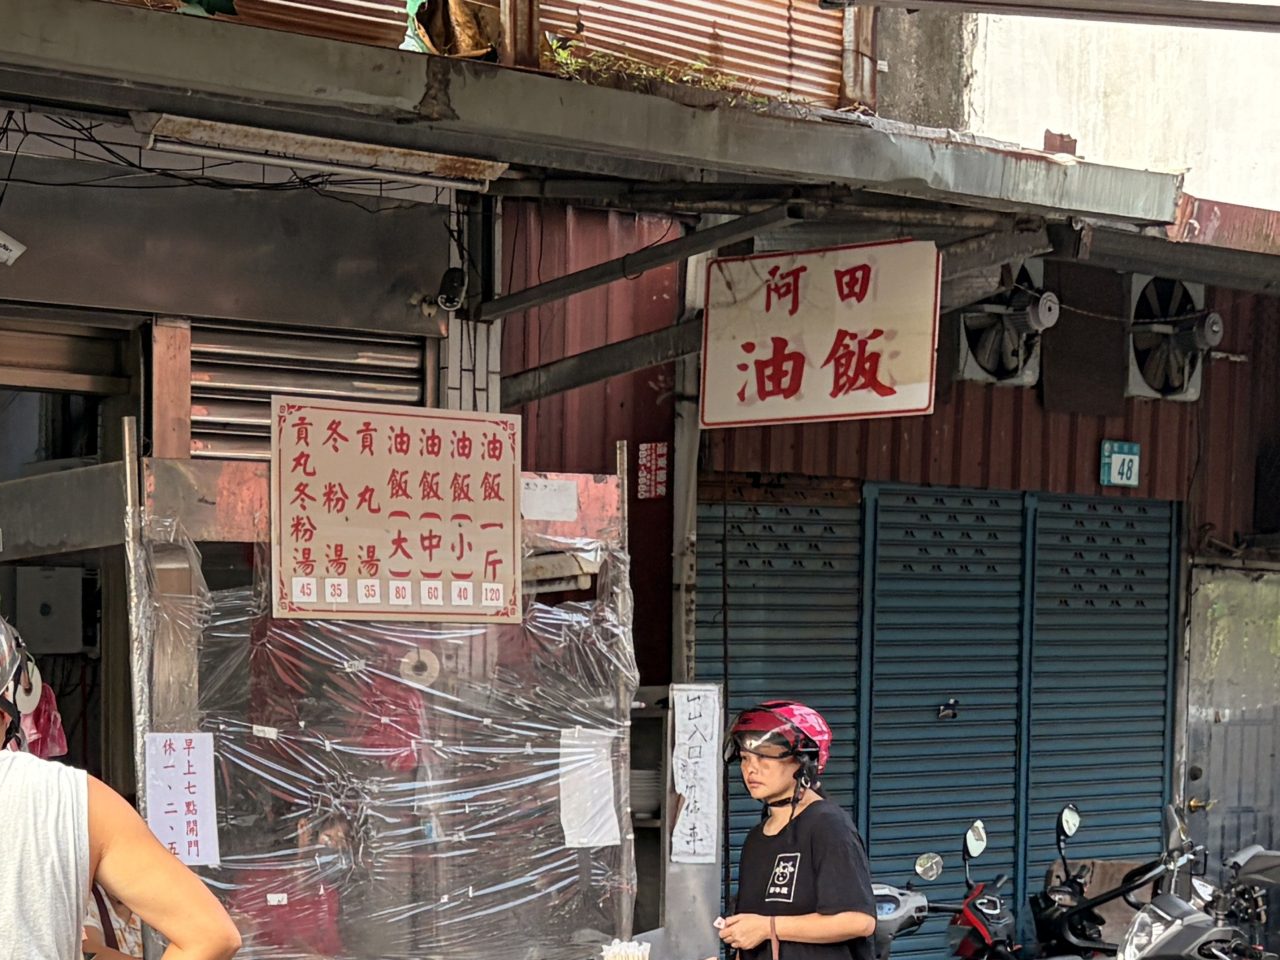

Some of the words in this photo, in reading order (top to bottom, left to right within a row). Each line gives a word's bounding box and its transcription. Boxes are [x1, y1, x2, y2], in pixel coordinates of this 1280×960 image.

[765, 264, 871, 316] 阿田
[737, 329, 897, 402] 油飯
[1118, 458, 1134, 481] 48
[290, 416, 318, 577] 貢丸冬粉湯
[322, 419, 349, 576] 冬粉湯
[356, 422, 381, 577] 貢丸湯
[480, 432, 505, 581] 油飯一斤
[300, 583, 312, 598] 45
[330, 584, 343, 598] 35
[364, 584, 376, 598] 35
[395, 584, 407, 599] 80
[427, 585, 439, 600] 60
[457, 584, 468, 600] 40
[484, 587, 501, 602] 120
[183, 738, 200, 858] 早上七點開門
